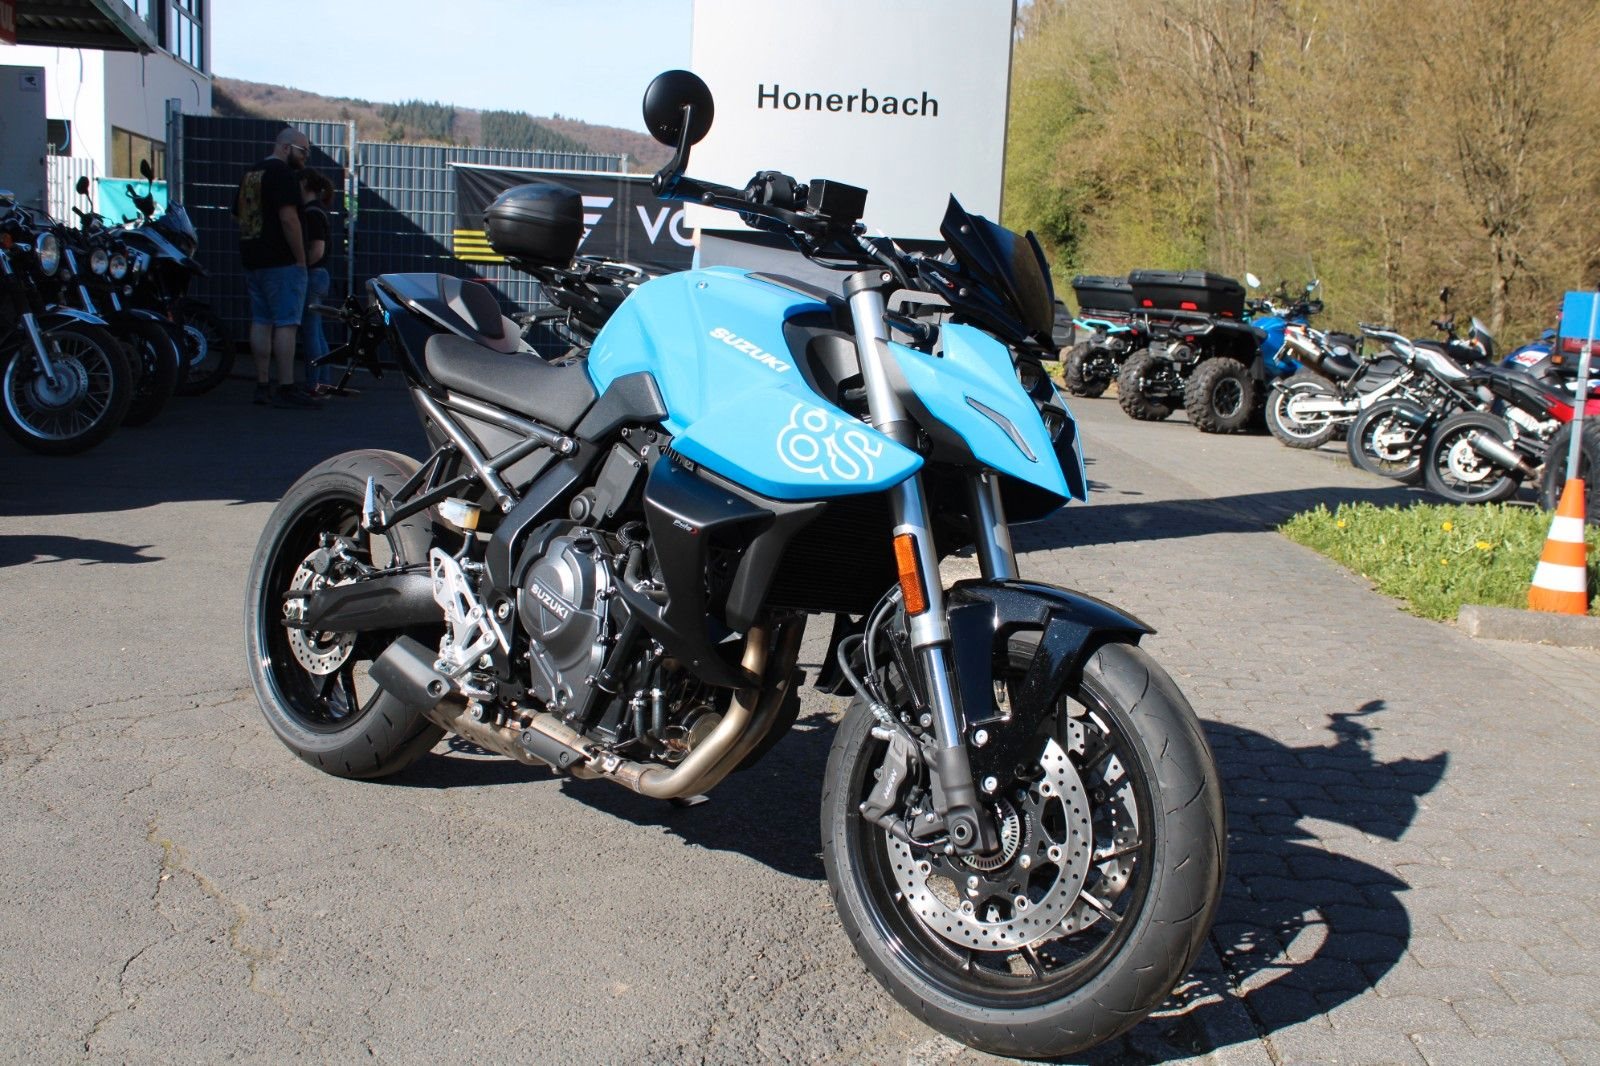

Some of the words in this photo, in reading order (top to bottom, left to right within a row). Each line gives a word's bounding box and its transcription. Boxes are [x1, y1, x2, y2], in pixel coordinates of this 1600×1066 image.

[758, 84, 939, 116] Honerbach
[709, 327, 791, 373] SUZUKI
[531, 583, 569, 619] SUZUKI
